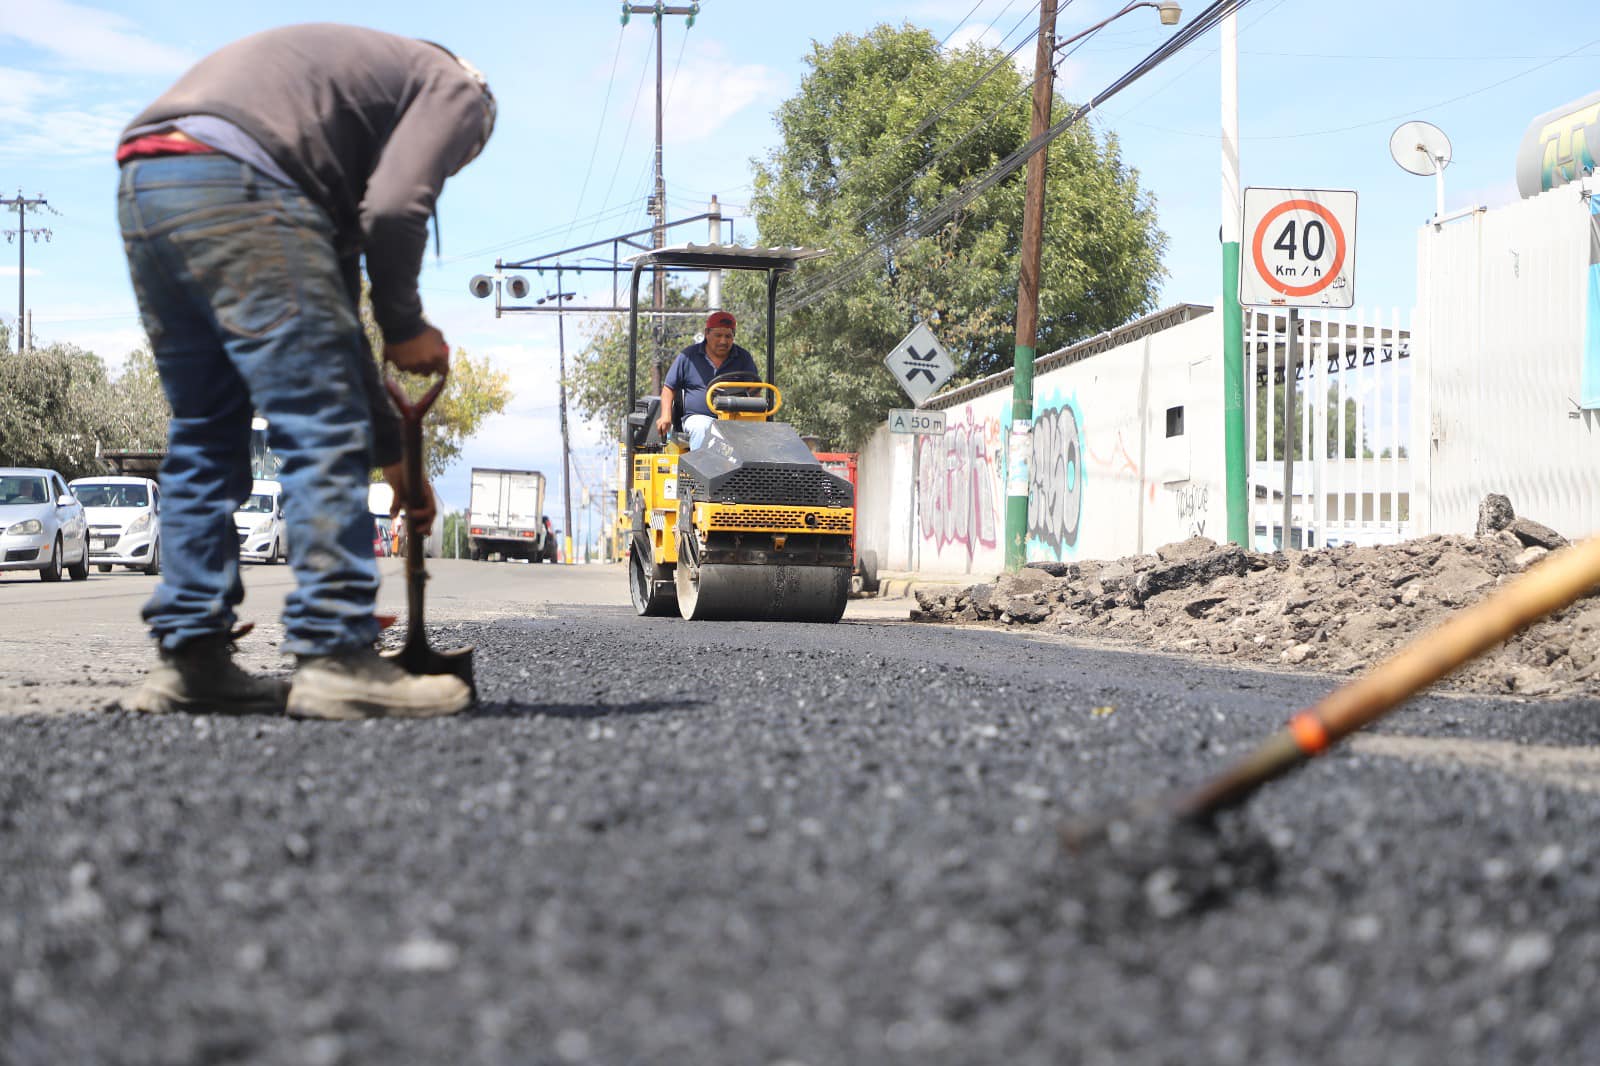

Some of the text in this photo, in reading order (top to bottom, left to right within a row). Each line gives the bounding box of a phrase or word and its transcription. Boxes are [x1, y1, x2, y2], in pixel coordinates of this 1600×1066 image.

[1273, 220, 1326, 261] 40
[894, 415, 942, 431] A 50 m
